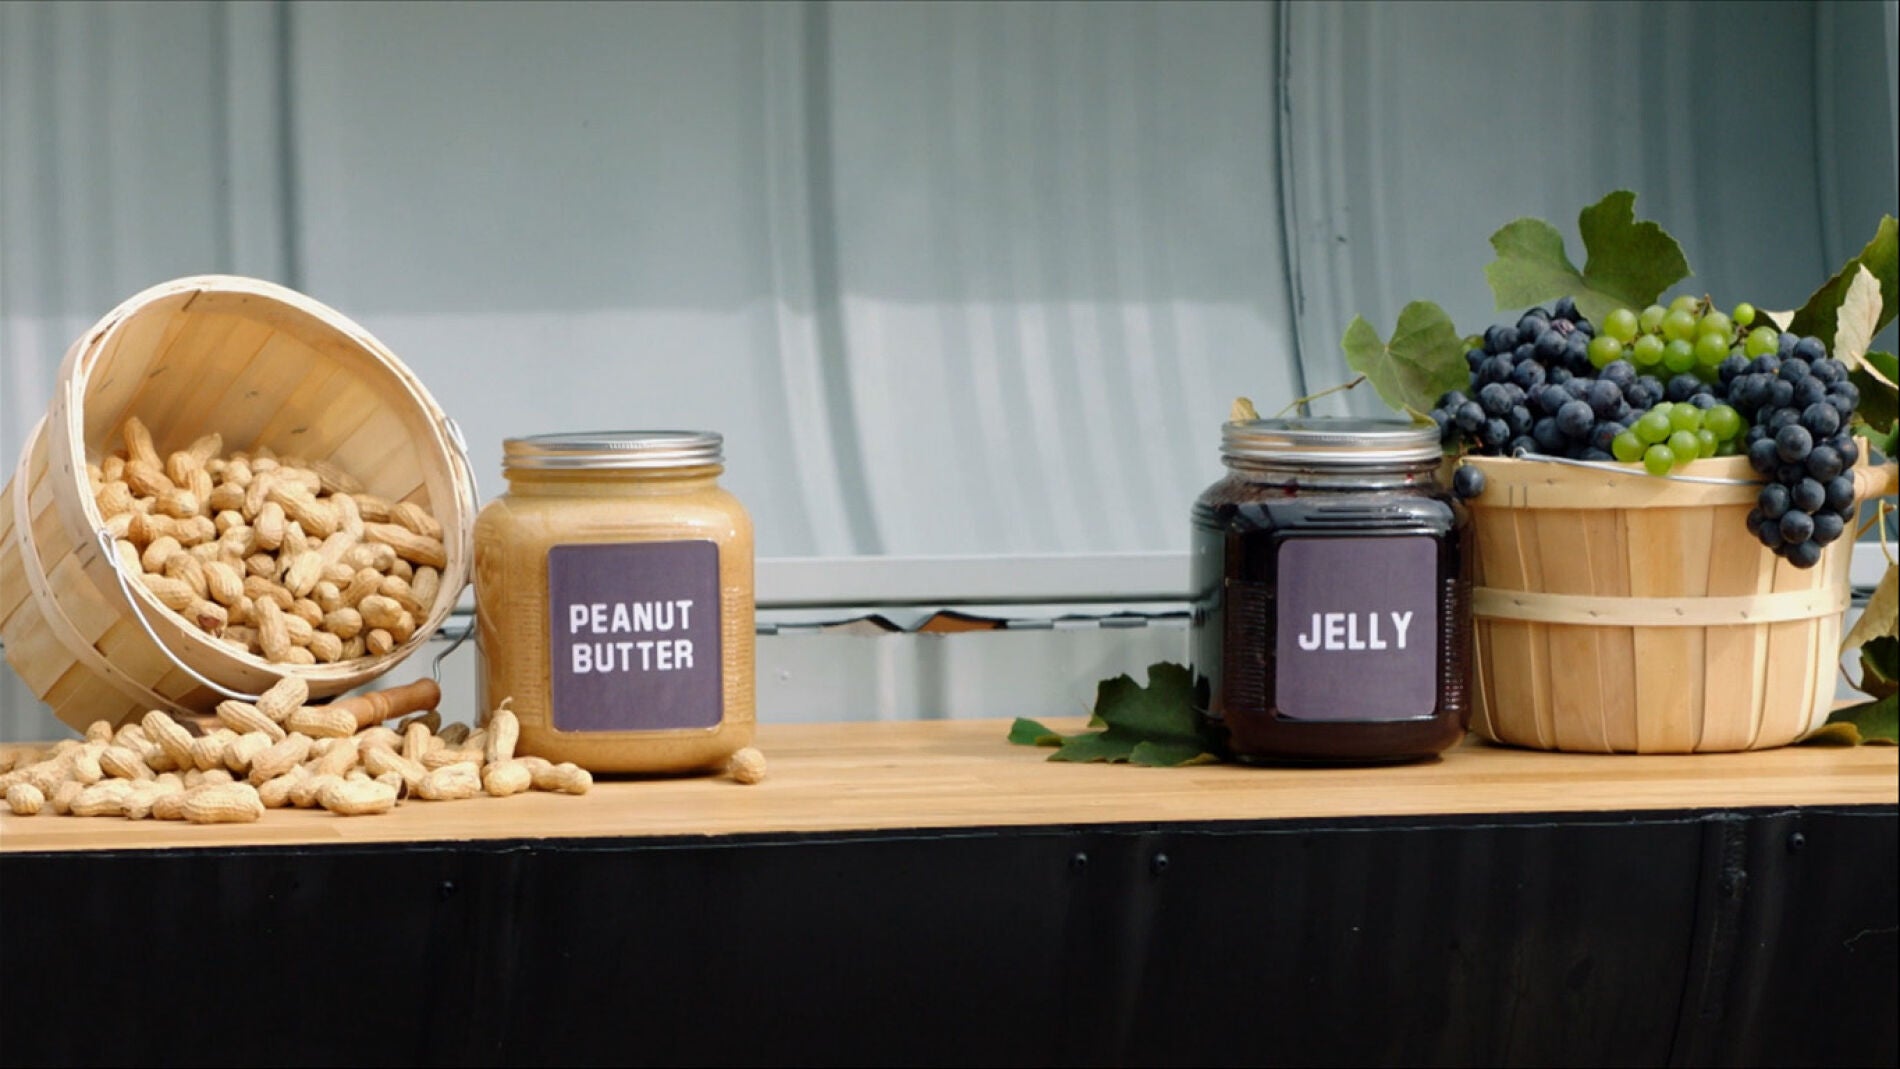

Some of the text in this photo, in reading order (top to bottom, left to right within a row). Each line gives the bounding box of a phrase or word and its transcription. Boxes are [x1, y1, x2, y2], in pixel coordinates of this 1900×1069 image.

[569, 600, 694, 634] PEANUT
[1298, 610, 1414, 651] JELLY
[572, 638, 694, 674] BUTTER
